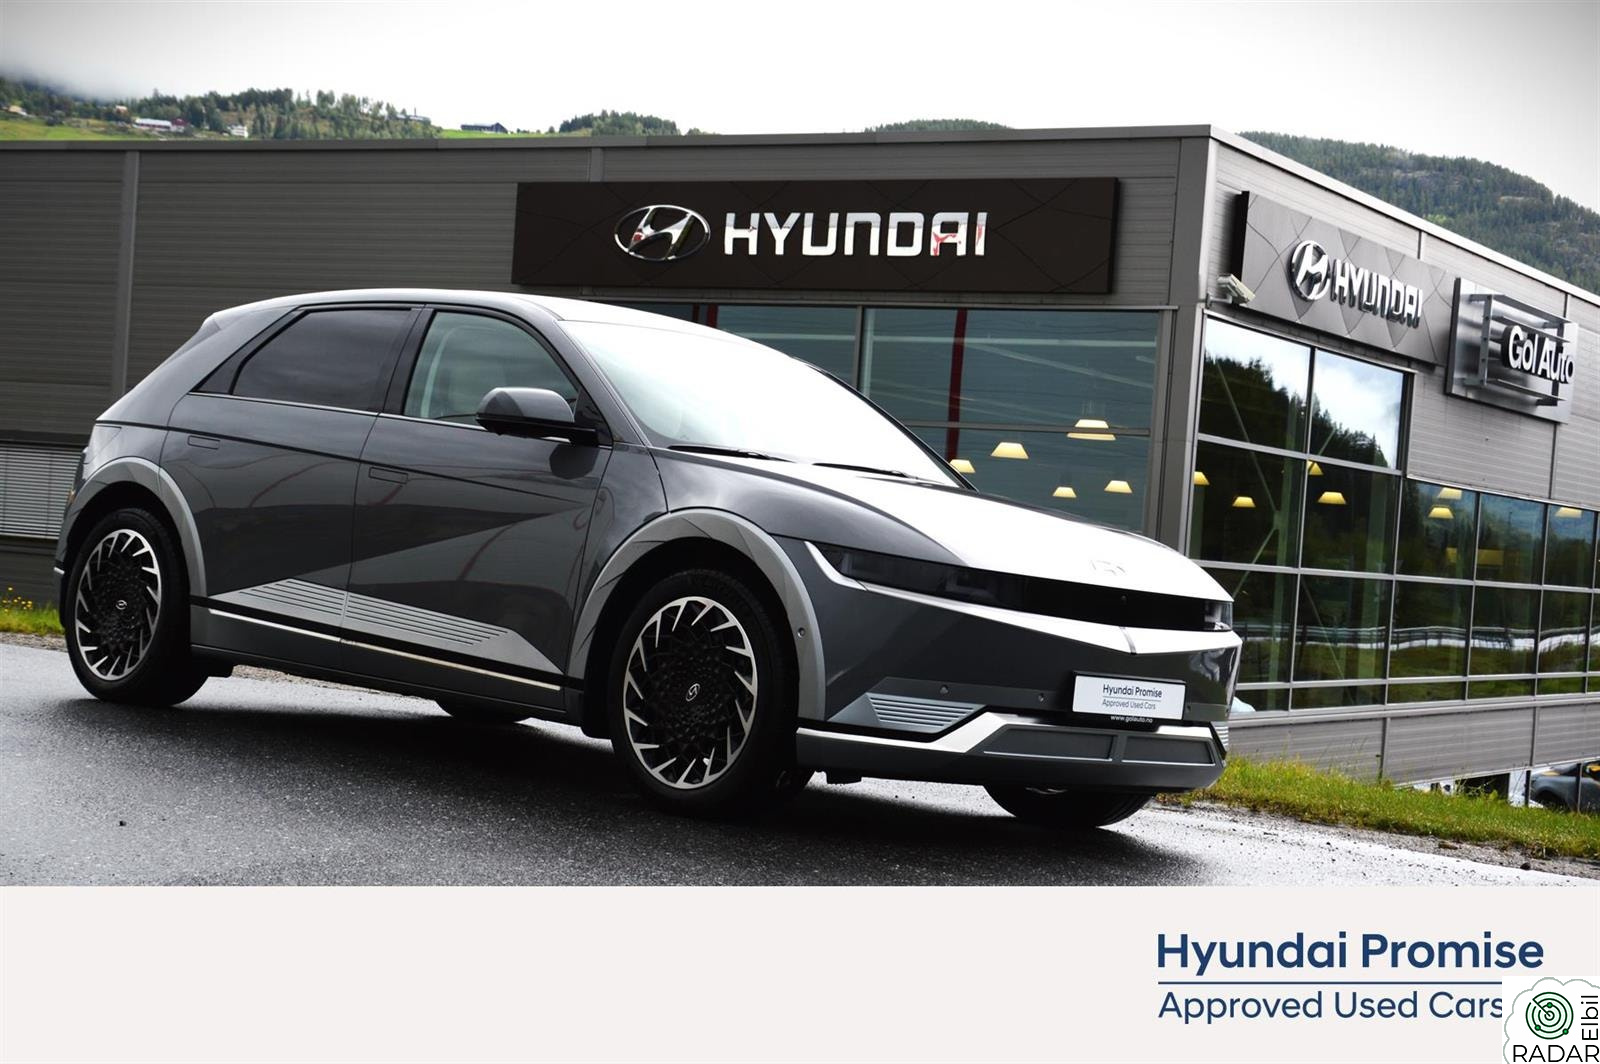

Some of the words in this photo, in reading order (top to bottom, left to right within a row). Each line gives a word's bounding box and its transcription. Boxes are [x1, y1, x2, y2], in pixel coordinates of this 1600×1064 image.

[723, 212, 988, 256] HYUNDAI
[1333, 258, 1423, 325] HYUNDAI
[1507, 325, 1539, 374] Gol
[1537, 336, 1576, 384] Auto
[1102, 698, 1130, 708] Approved
[1130, 700, 1143, 709] Used
[1144, 701, 1156, 710] Cars
[1103, 684, 1134, 695] Hyundai
[1135, 686, 1162, 698] Promise
